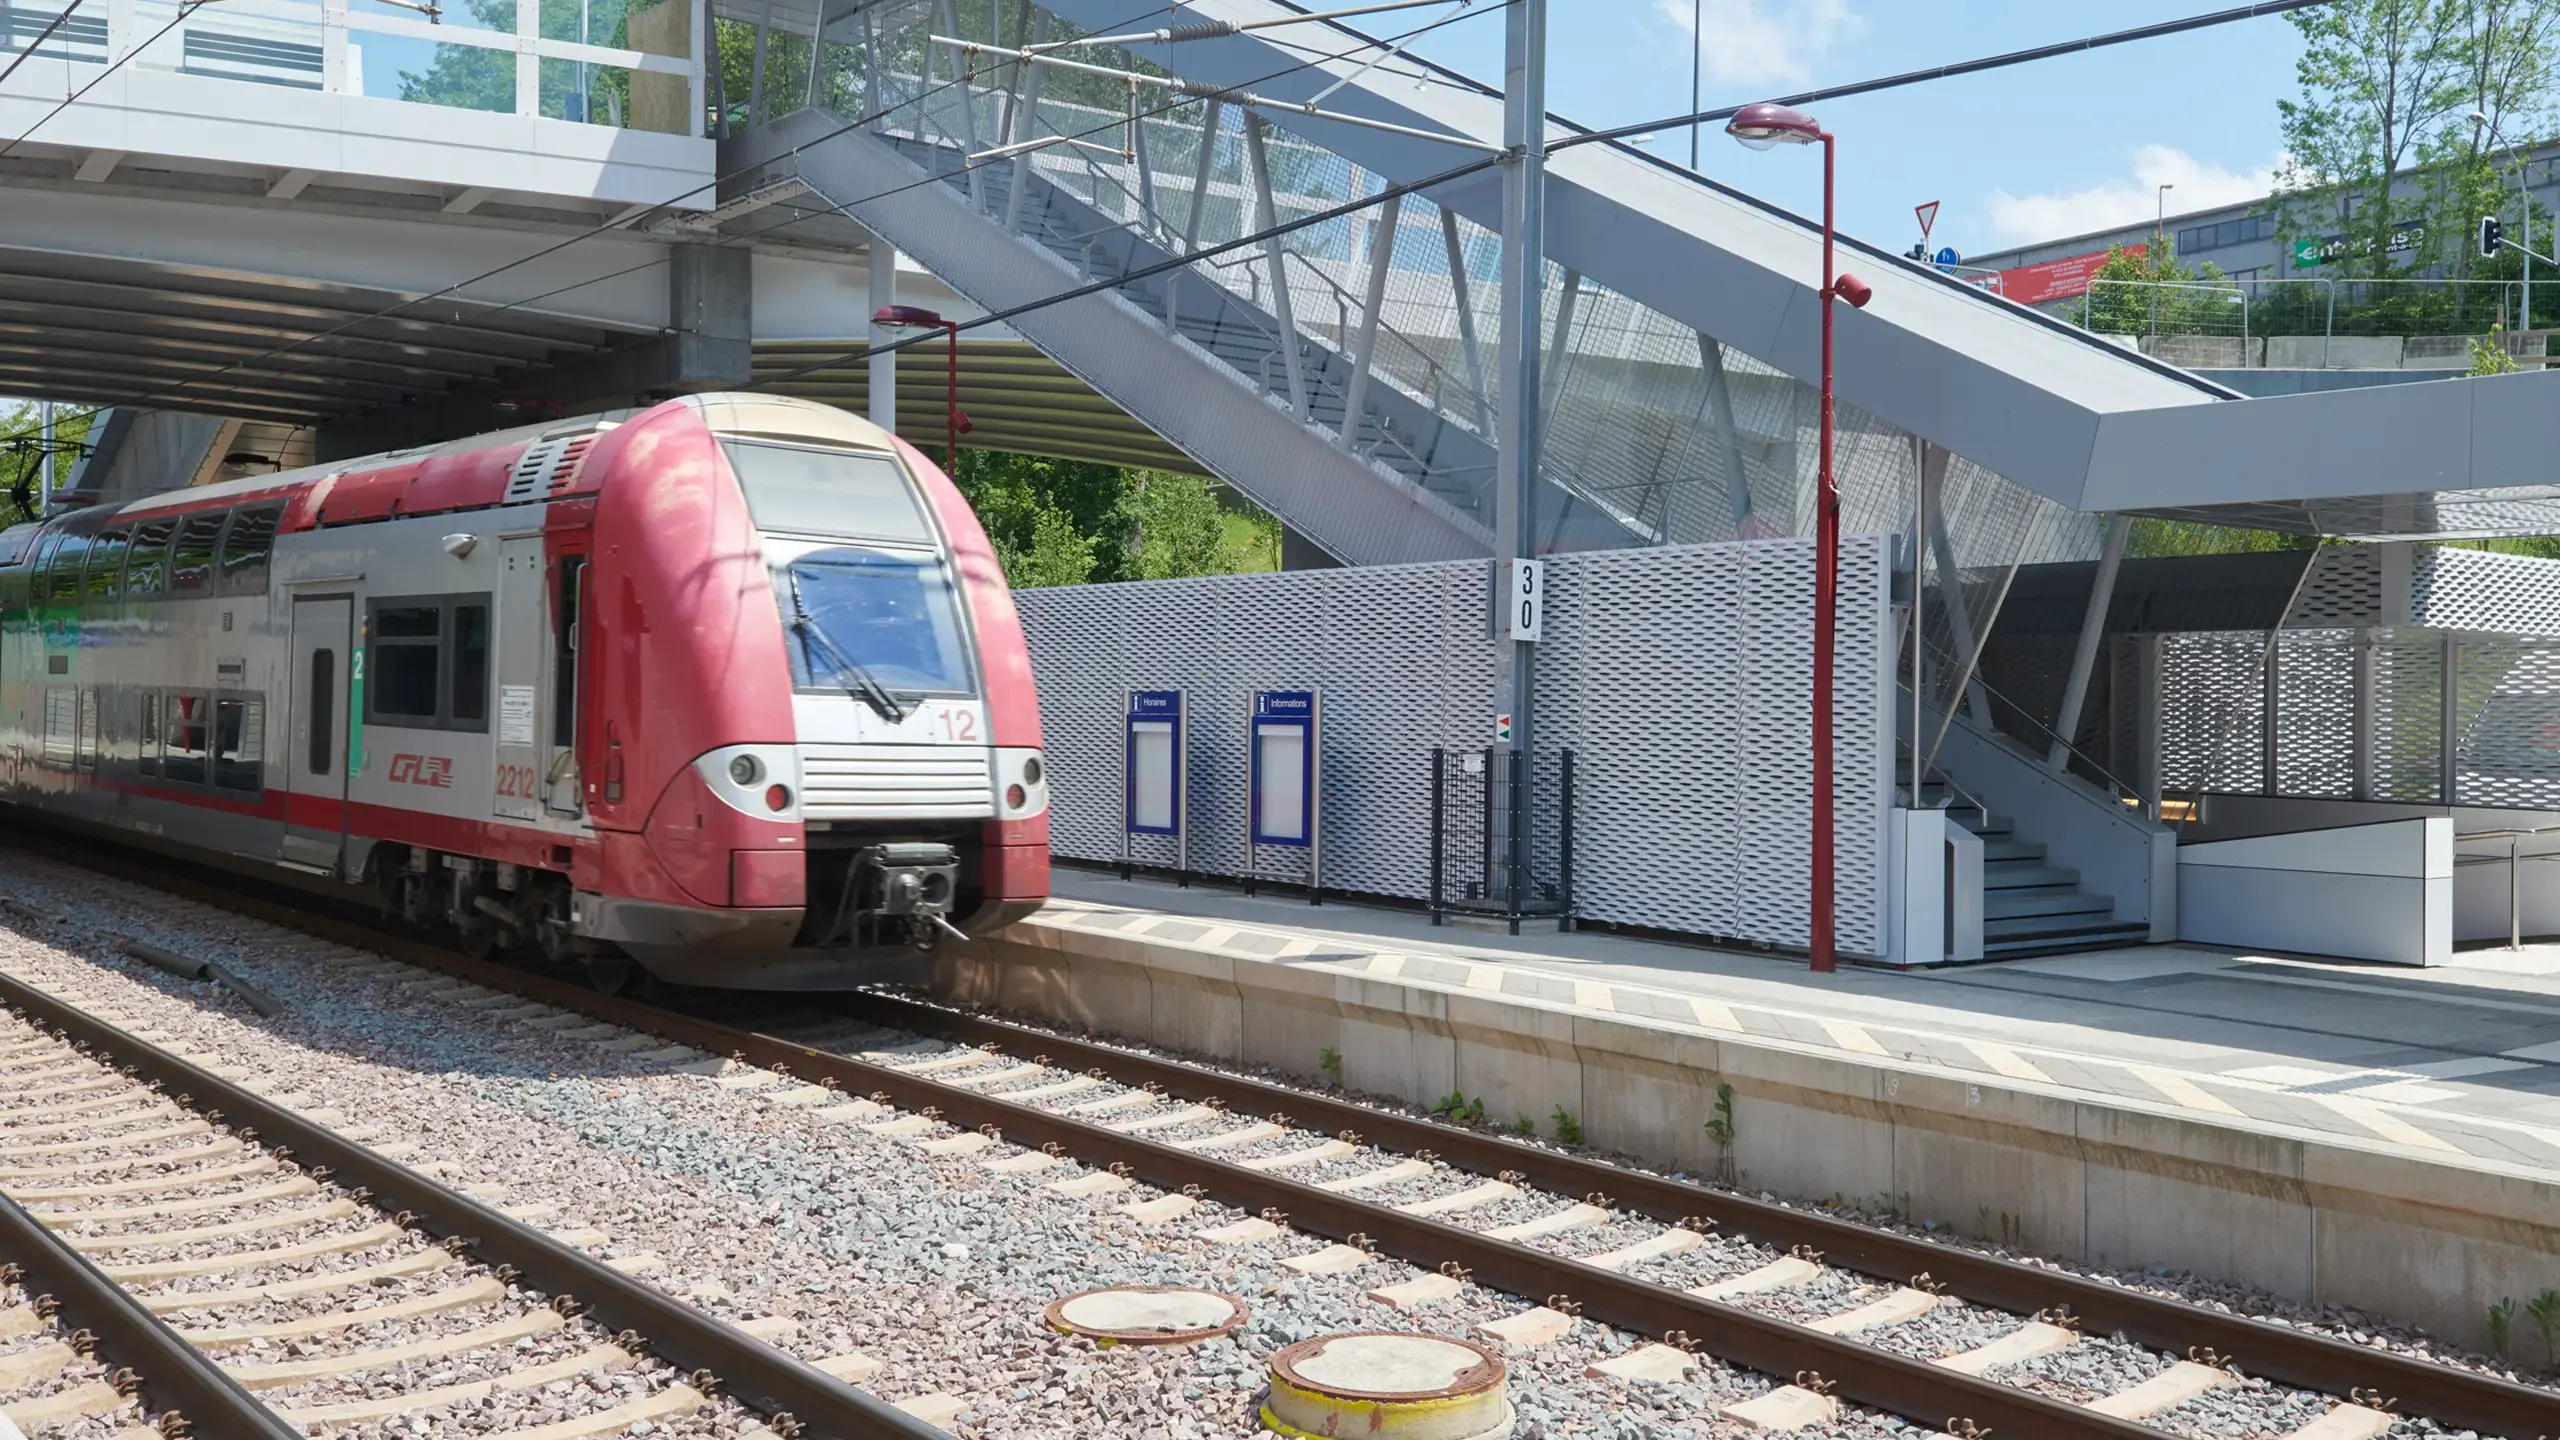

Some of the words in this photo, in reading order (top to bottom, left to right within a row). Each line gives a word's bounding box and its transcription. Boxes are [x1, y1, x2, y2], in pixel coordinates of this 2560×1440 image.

[354, 650, 364, 680] 2
[1143, 697, 1167, 707] Horaires
[1270, 698, 1307, 709] Informations
[939, 709, 976, 742] 12
[497, 764, 535, 799] 2212
